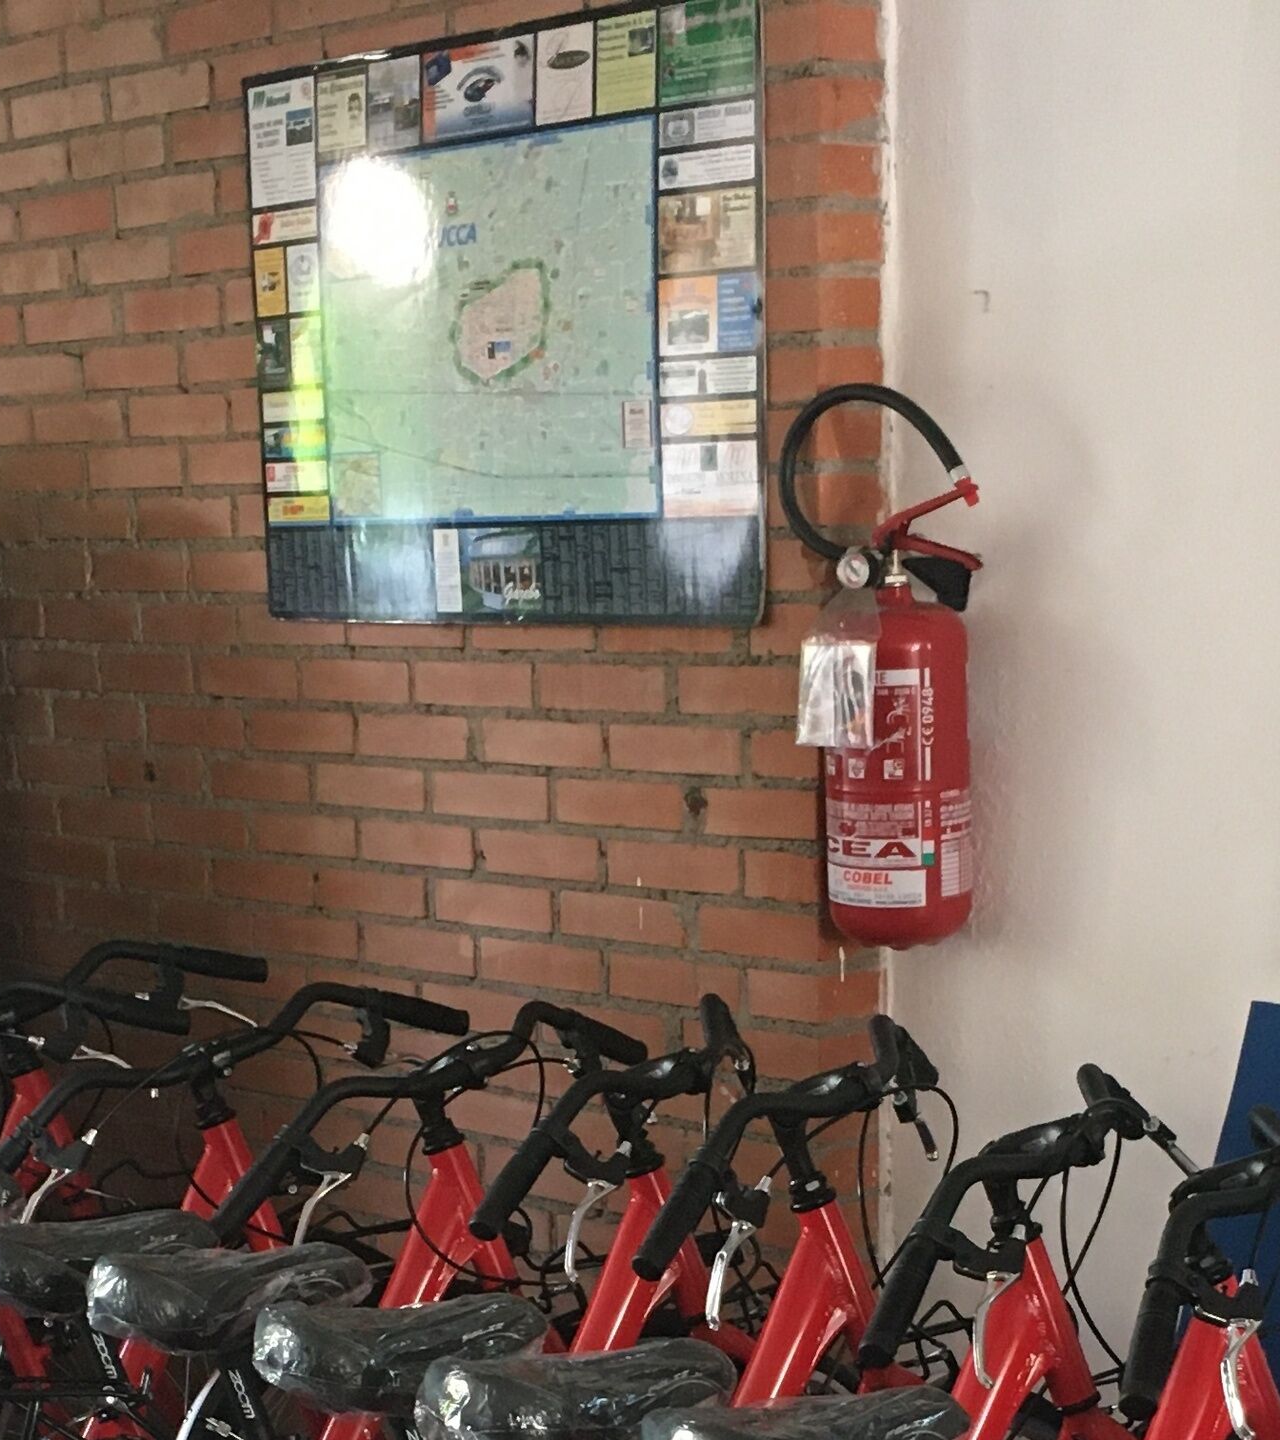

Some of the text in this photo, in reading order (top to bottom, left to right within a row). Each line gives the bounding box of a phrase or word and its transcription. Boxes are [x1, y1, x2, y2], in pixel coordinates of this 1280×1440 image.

[842, 869, 893, 886] COBEL
[91, 1332, 118, 1379] ZOOM
[228, 1369, 256, 1419] ZOOM
